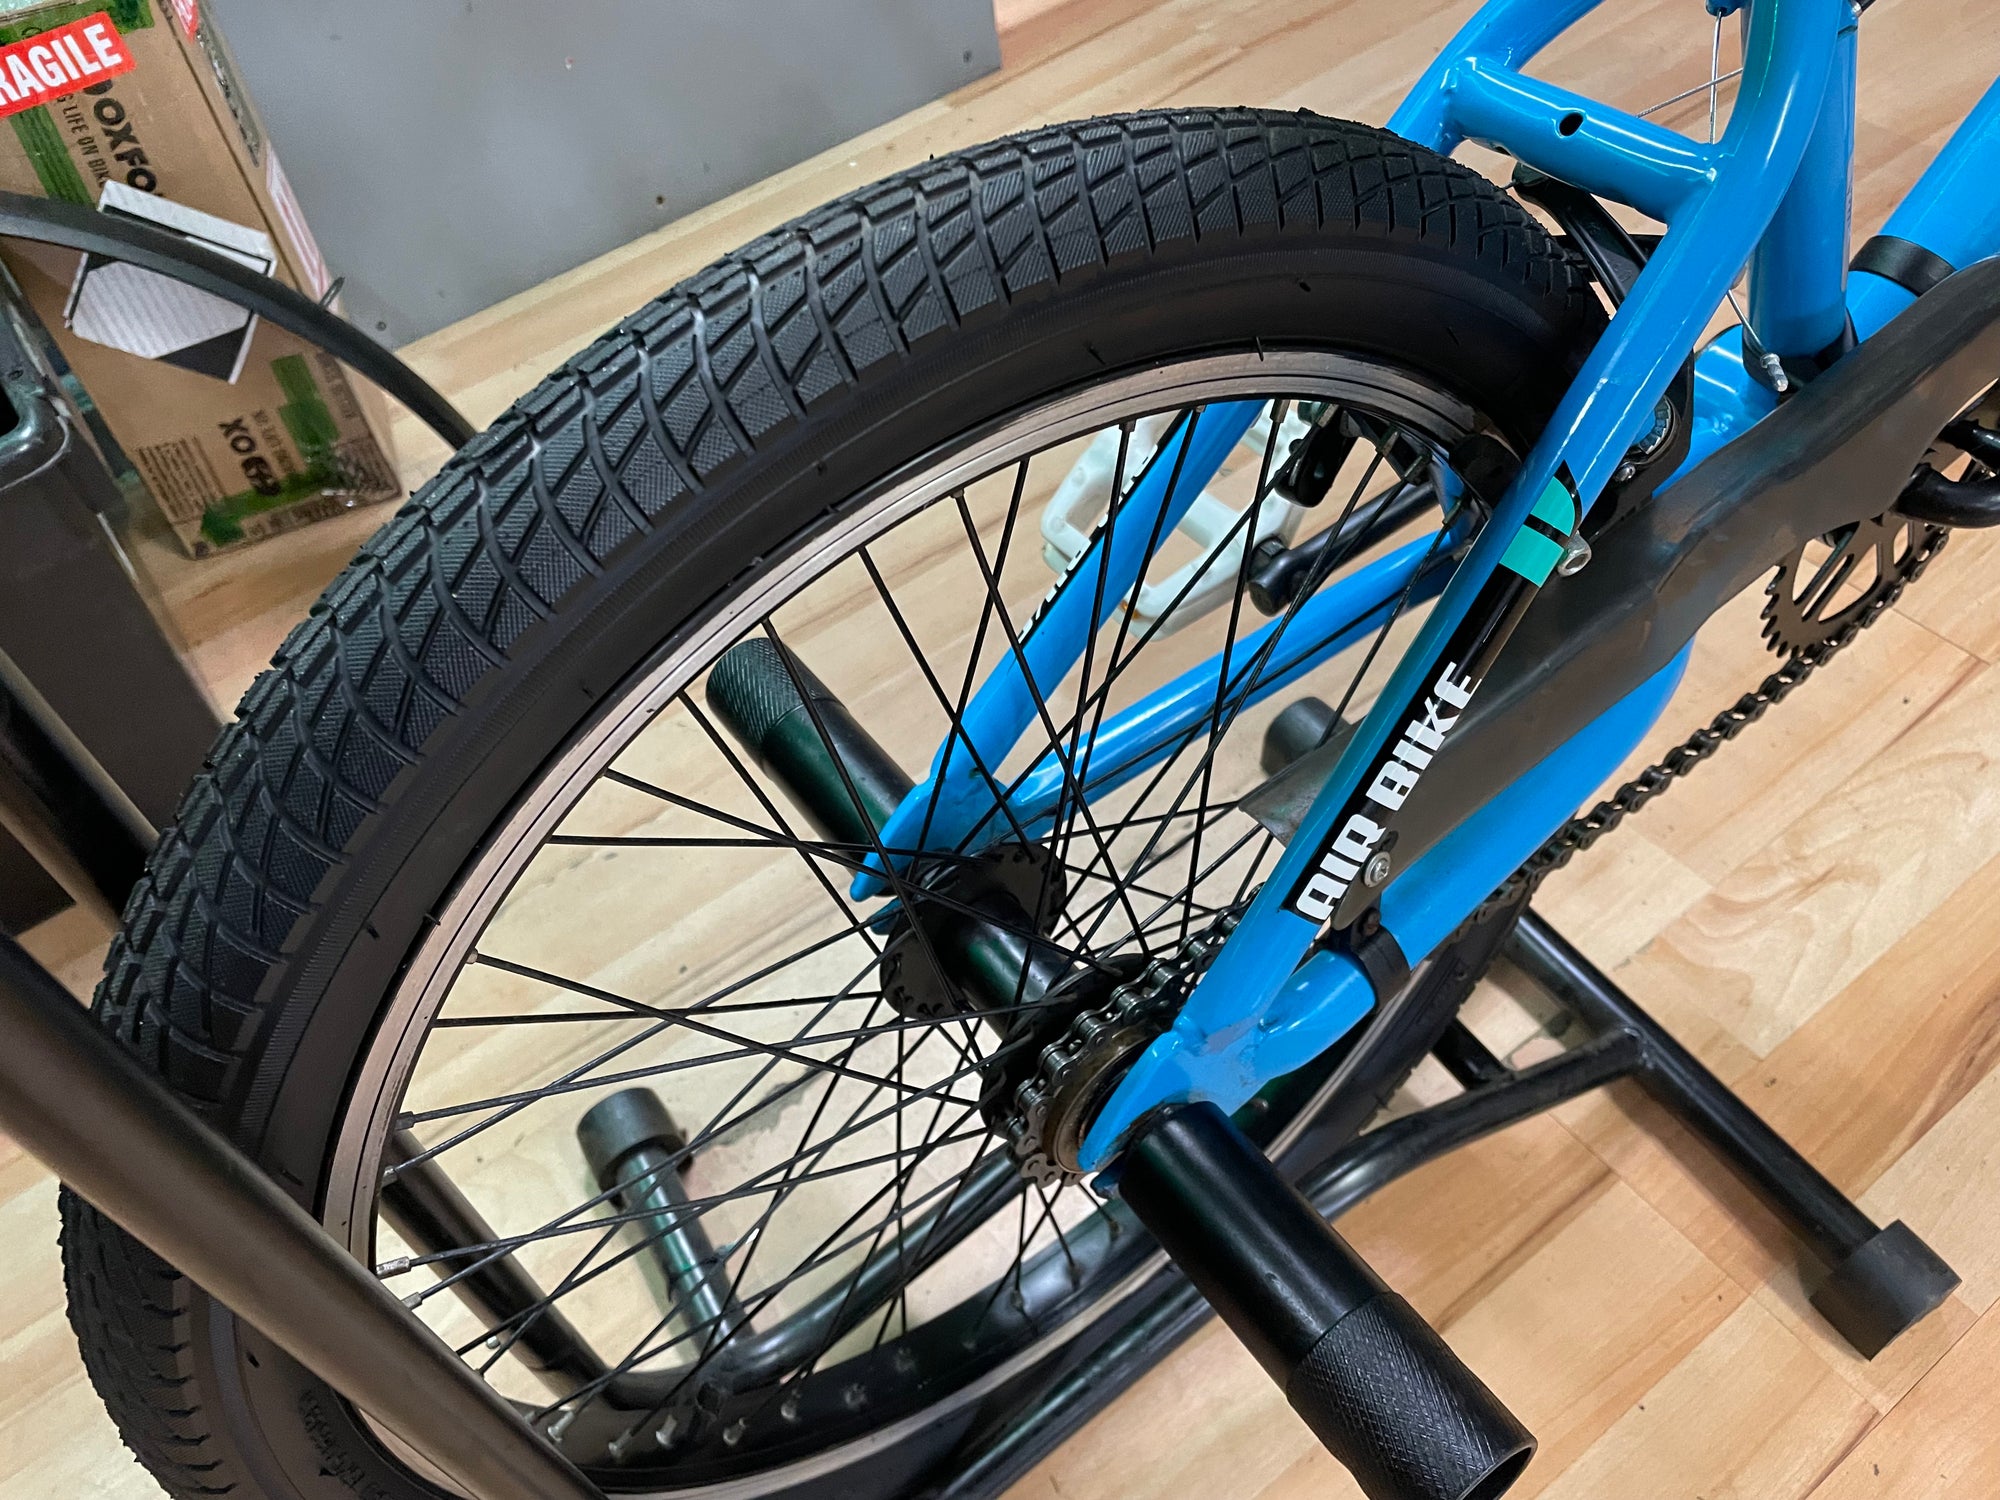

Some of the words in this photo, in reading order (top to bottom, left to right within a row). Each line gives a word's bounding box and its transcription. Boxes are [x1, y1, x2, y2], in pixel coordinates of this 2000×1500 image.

[62, 104, 90, 134] LIFE
[77, 136, 99, 156] ON
[93, 97, 160, 196] OXFO
[1296, 813, 1387, 920] AIR
[1365, 661, 1482, 811] BIKE
